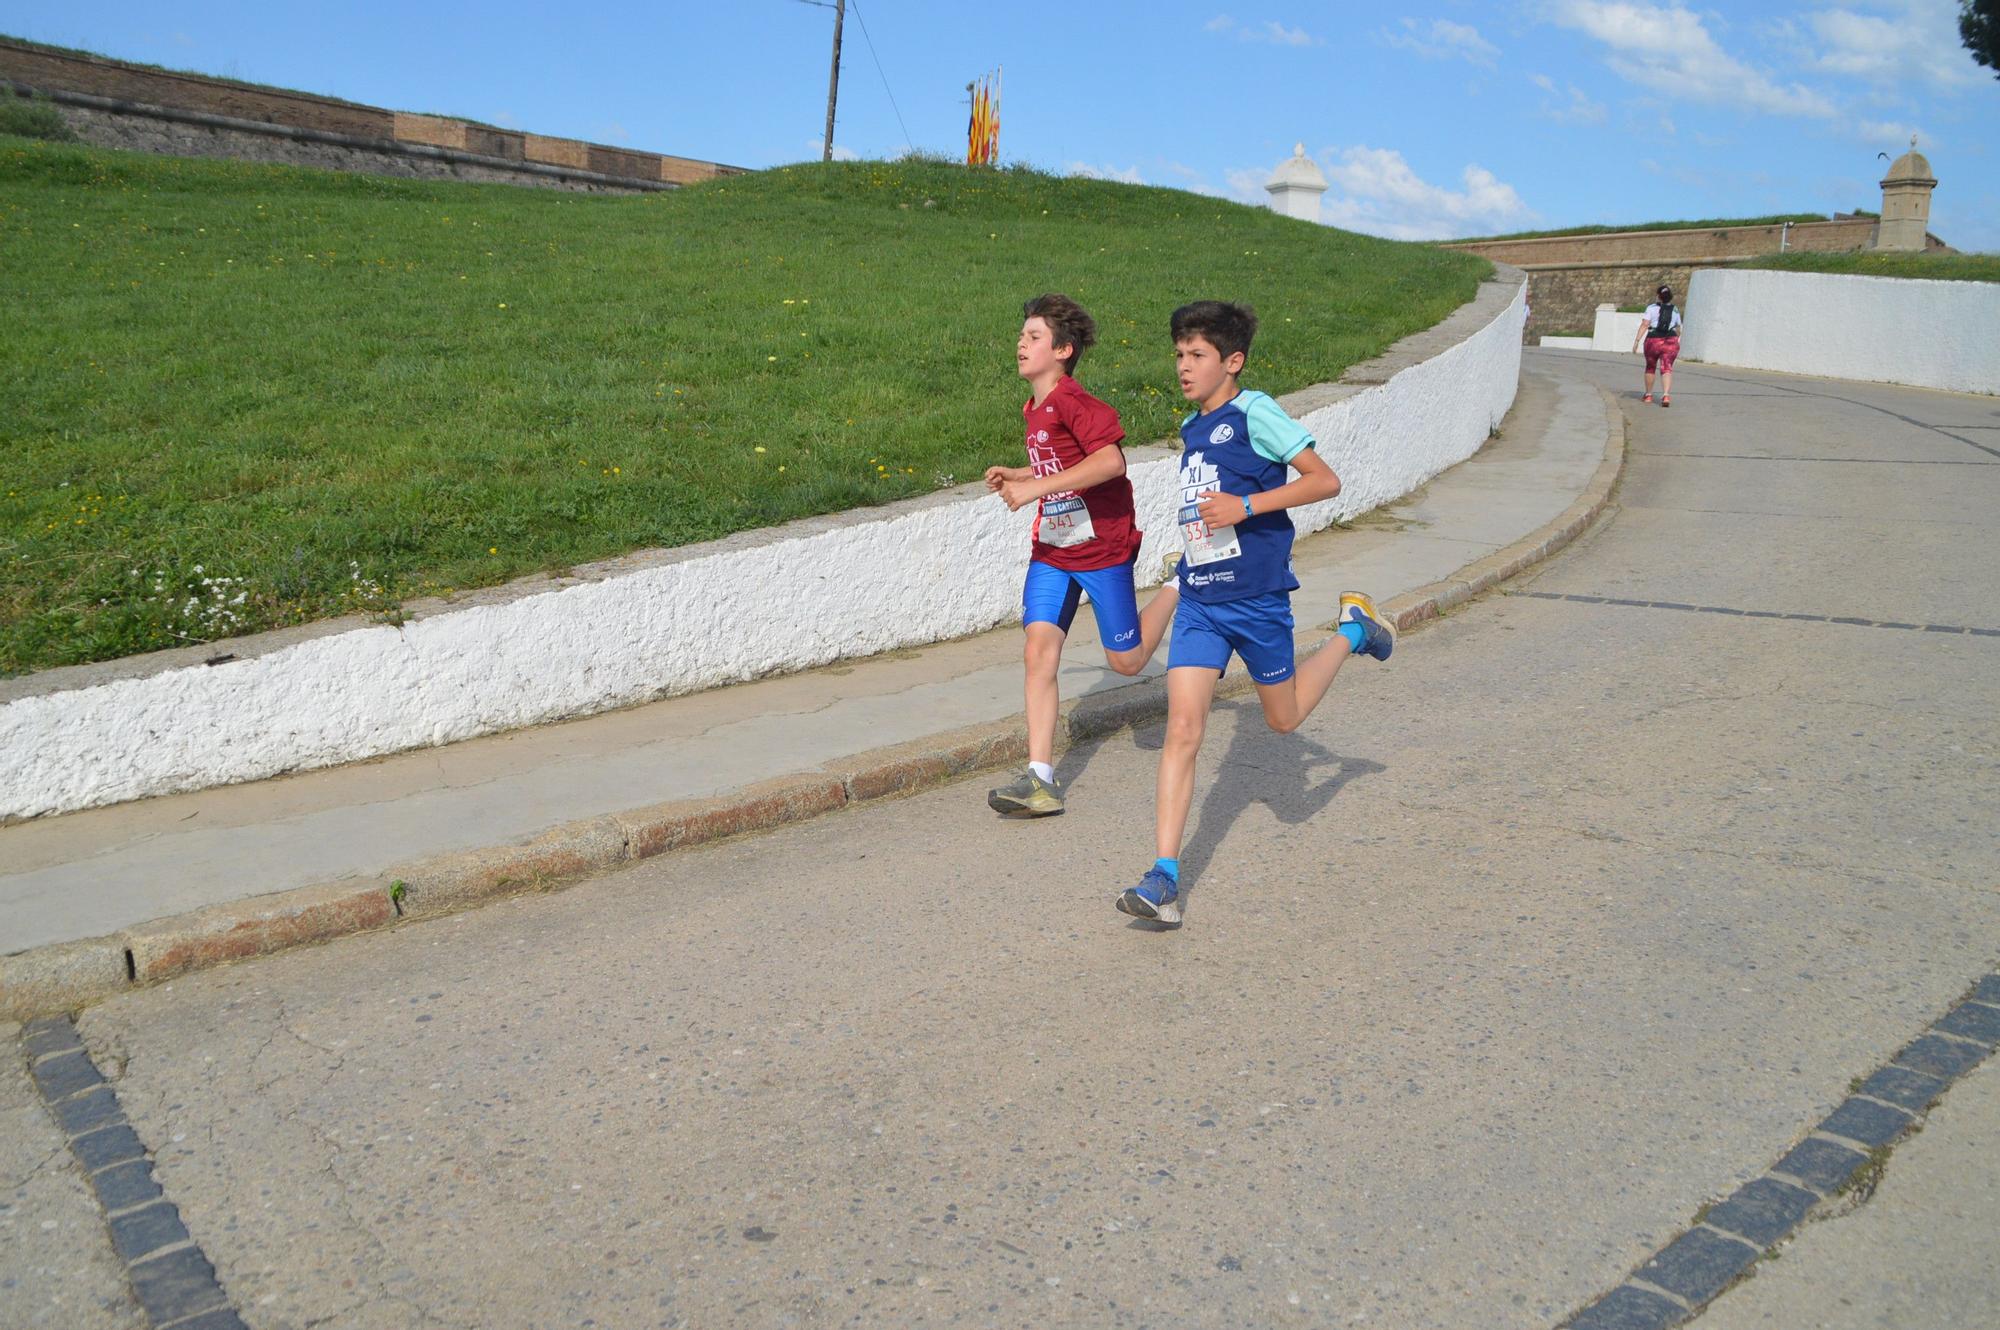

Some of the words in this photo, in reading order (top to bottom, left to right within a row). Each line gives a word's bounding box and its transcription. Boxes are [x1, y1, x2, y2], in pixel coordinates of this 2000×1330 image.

[1188, 465, 1202, 484] XI
[1057, 499, 1083, 512] CASTELL
[1046, 513, 1075, 530] 341
[1185, 521, 1213, 542] 331
[1114, 629, 1135, 642] CAF
